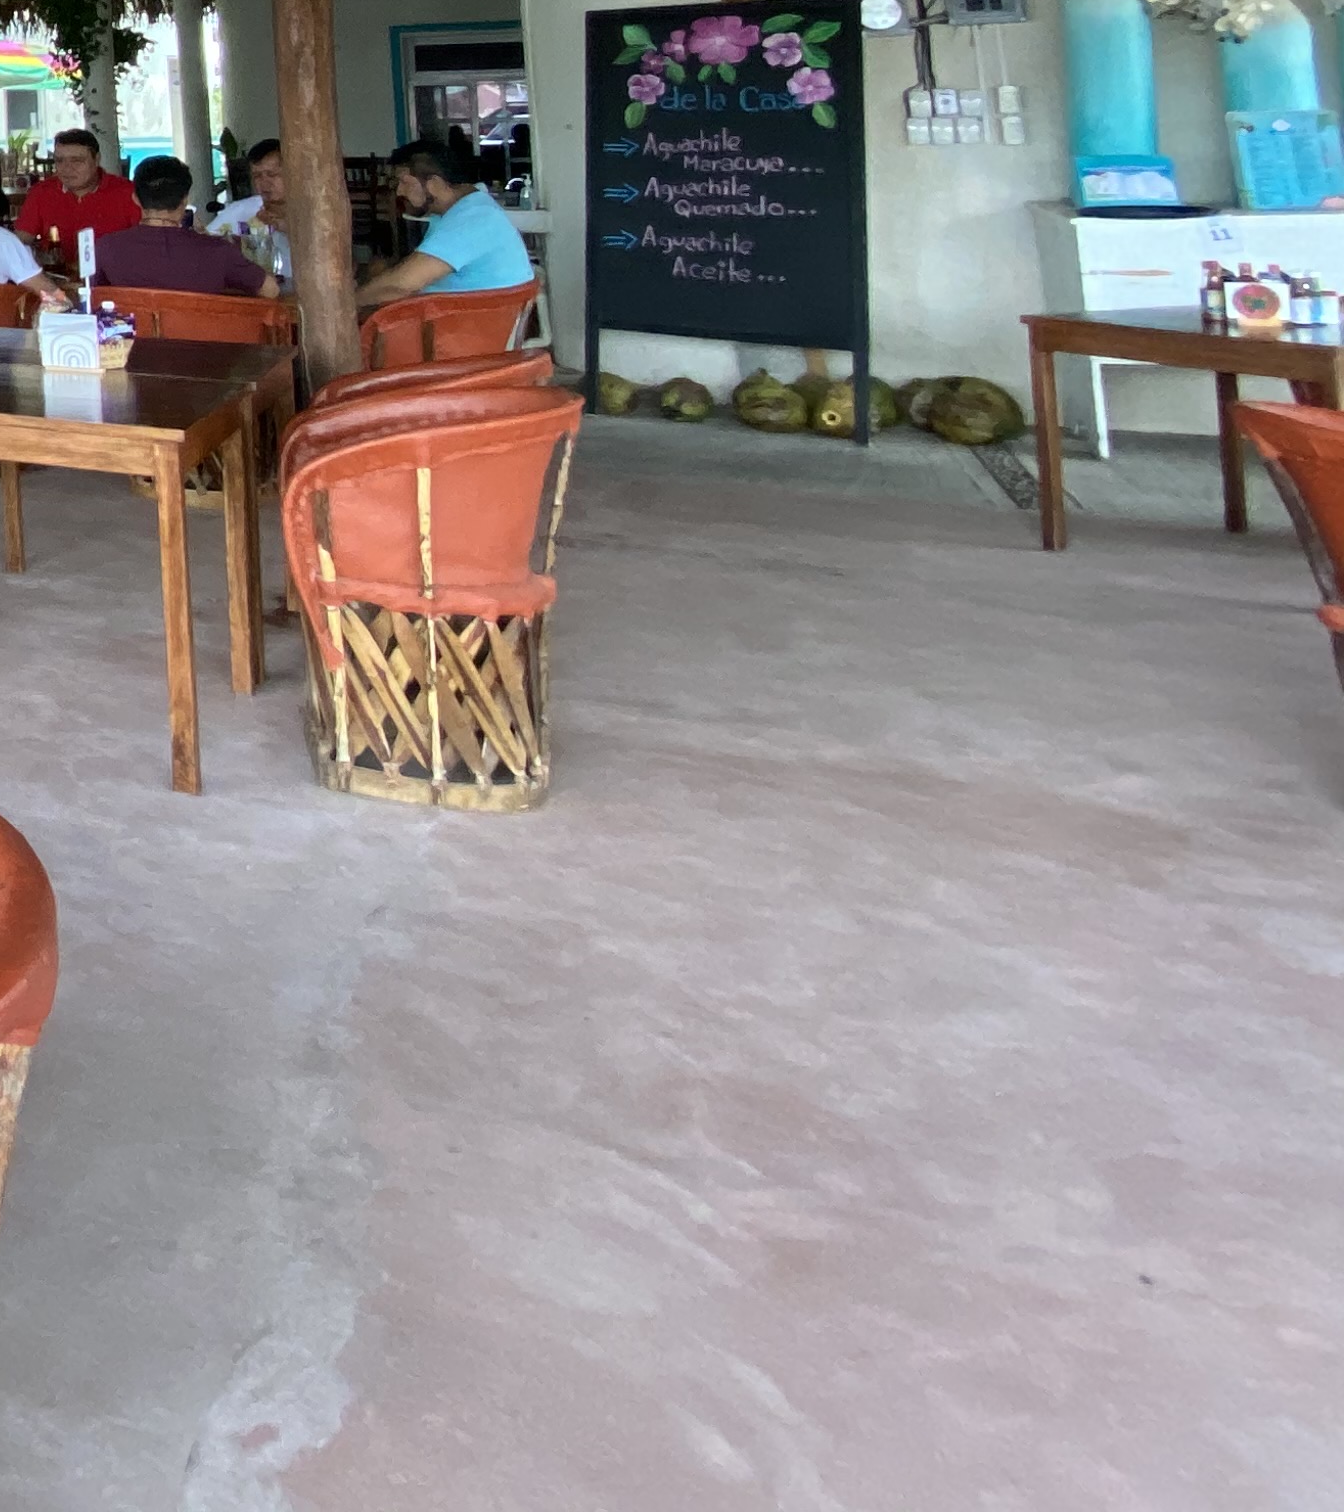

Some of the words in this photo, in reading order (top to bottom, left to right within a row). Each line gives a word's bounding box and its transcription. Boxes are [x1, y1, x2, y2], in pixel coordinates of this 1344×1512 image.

[659, 85, 697, 111] de
[705, 84, 727, 112] la
[643, 126, 743, 161] Aguachile
[644, 176, 751, 203] Aguachile
[641, 225, 754, 256] Aguachile
